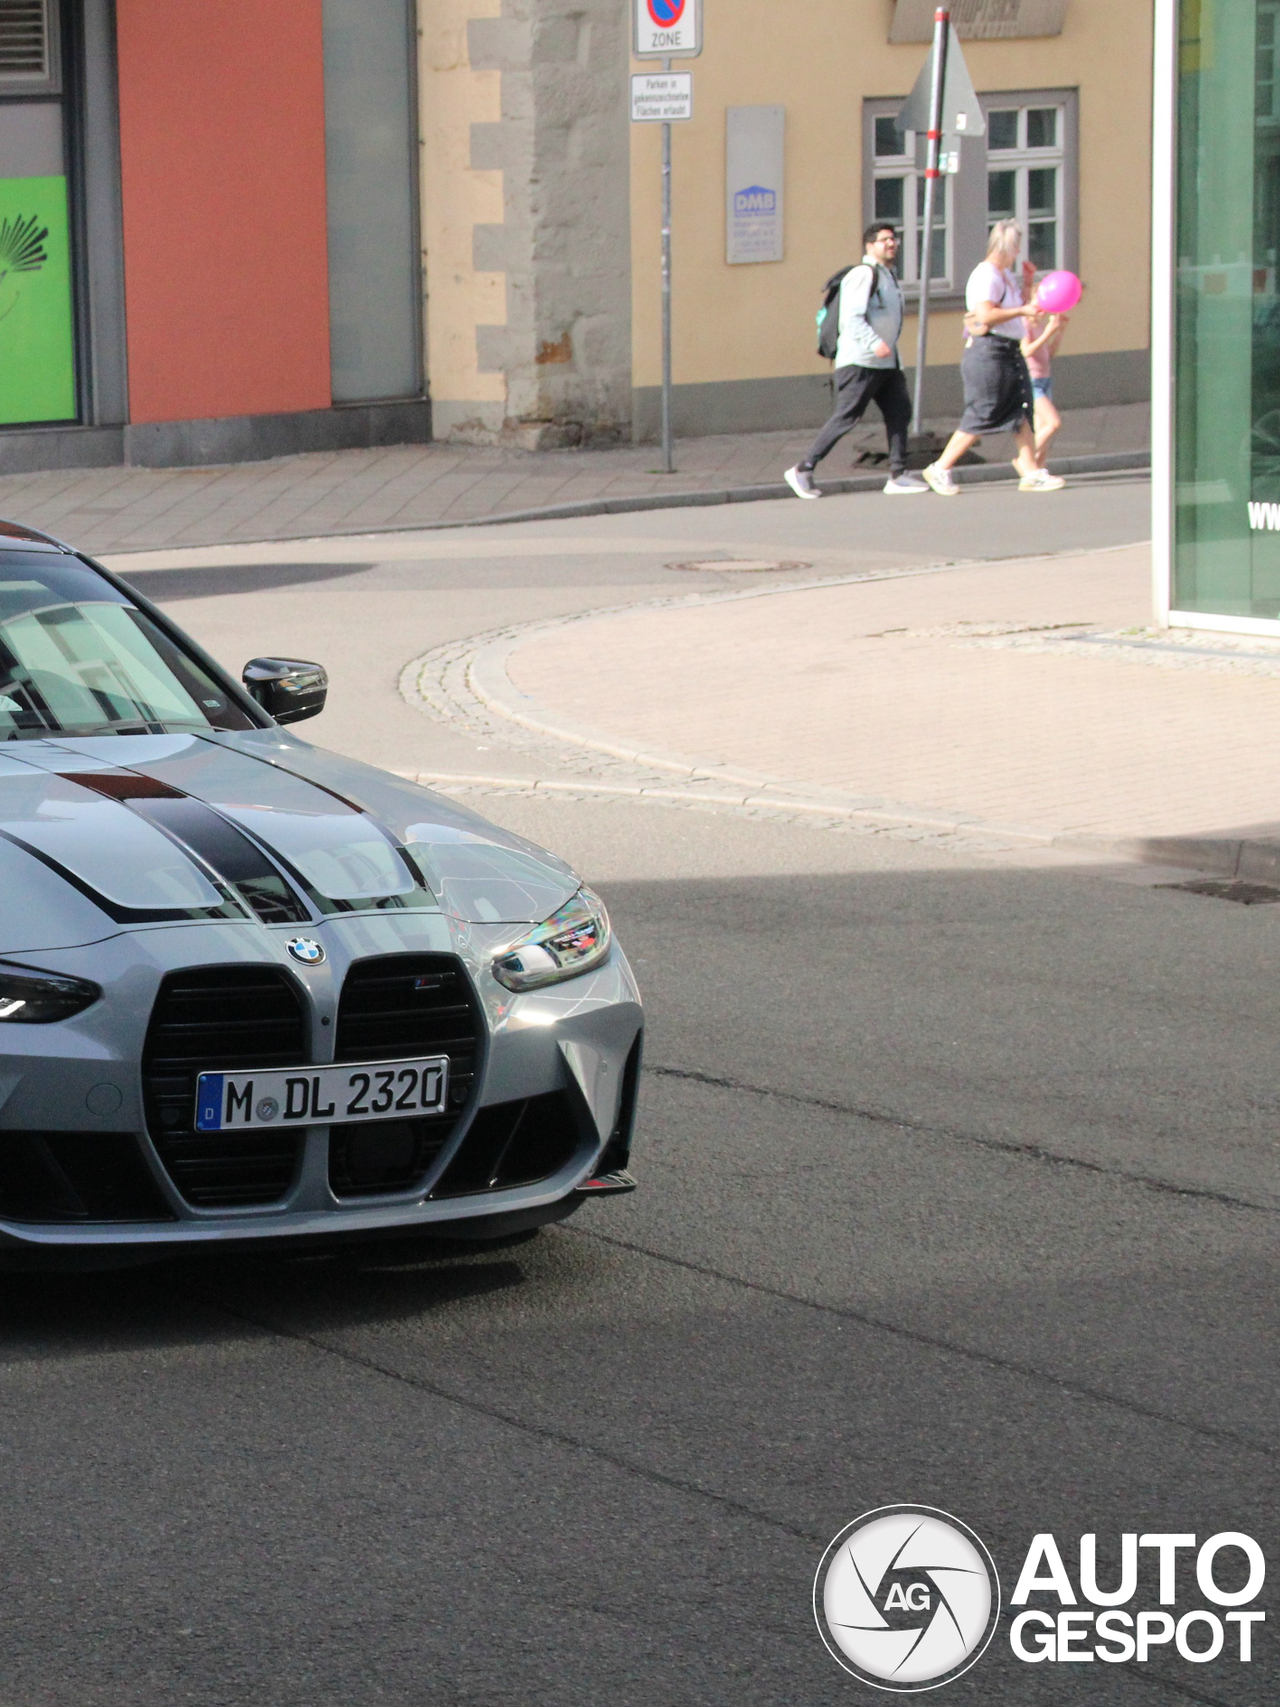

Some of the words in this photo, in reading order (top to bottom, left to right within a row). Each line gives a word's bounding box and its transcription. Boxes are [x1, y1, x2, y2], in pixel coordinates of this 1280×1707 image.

[651, 31, 682, 47] ZONE
[736, 192, 774, 211] DMB
[225, 1080, 254, 1123] M
[283, 1076, 335, 1120] DL
[347, 1066, 443, 1115] 2320
[204, 1107, 214, 1120] D
